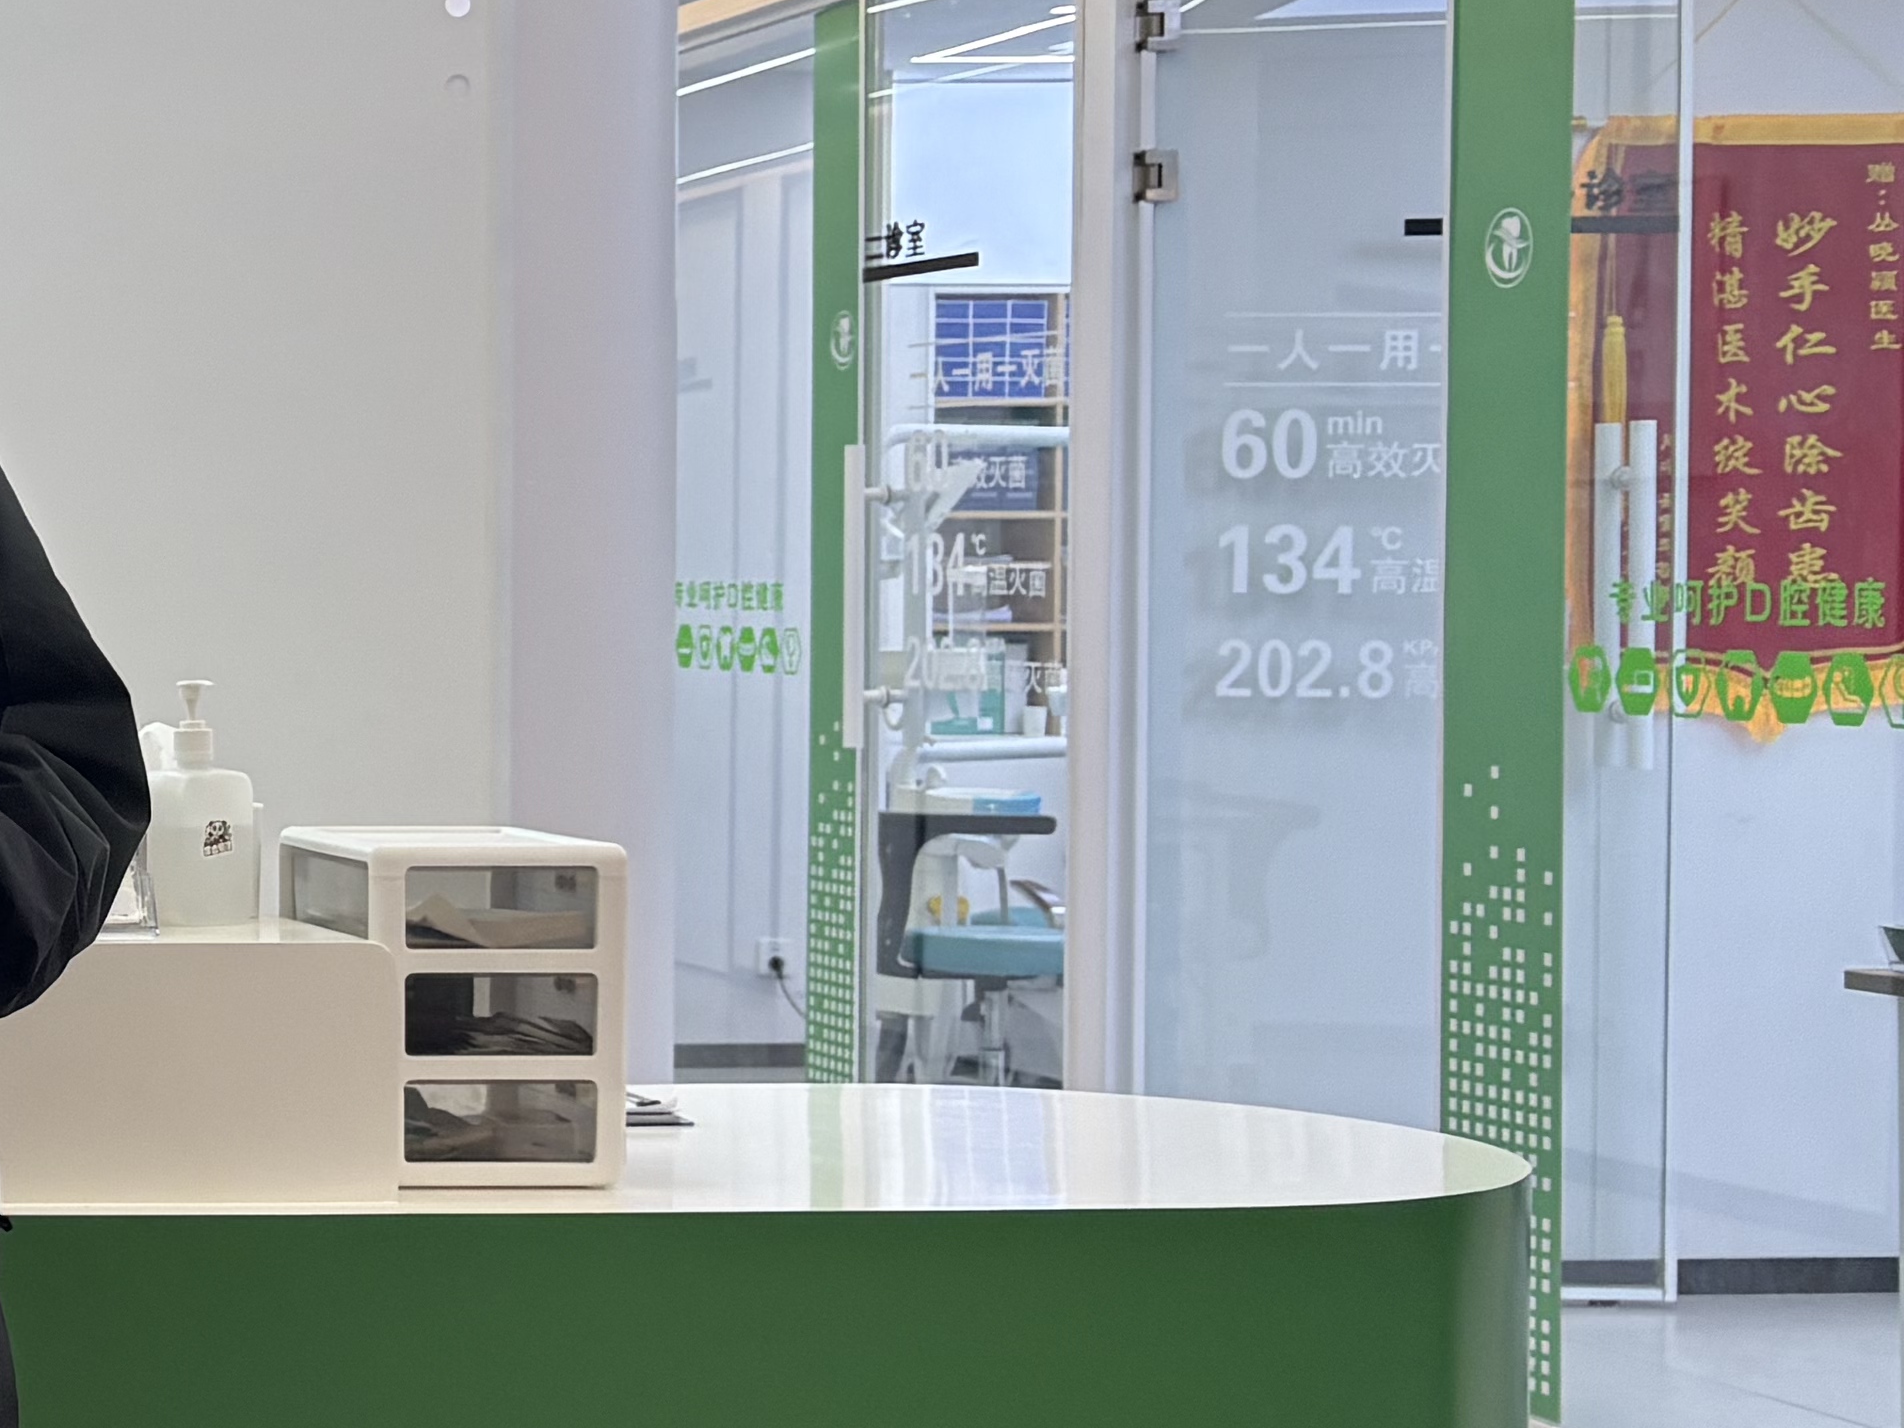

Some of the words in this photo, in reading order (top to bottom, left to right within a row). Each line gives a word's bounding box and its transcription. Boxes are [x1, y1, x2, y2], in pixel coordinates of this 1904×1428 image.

[1227, 328, 1441, 371] 一人一用
[1775, 211, 1842, 587] 妙手仁心除齿患
[1221, 408, 1318, 479] 60
[1327, 411, 1383, 435] min
[1218, 523, 1362, 595] 134
[1609, 578, 1885, 628] 专业呵护口腔健康
[1215, 639, 1393, 699] 202.8
